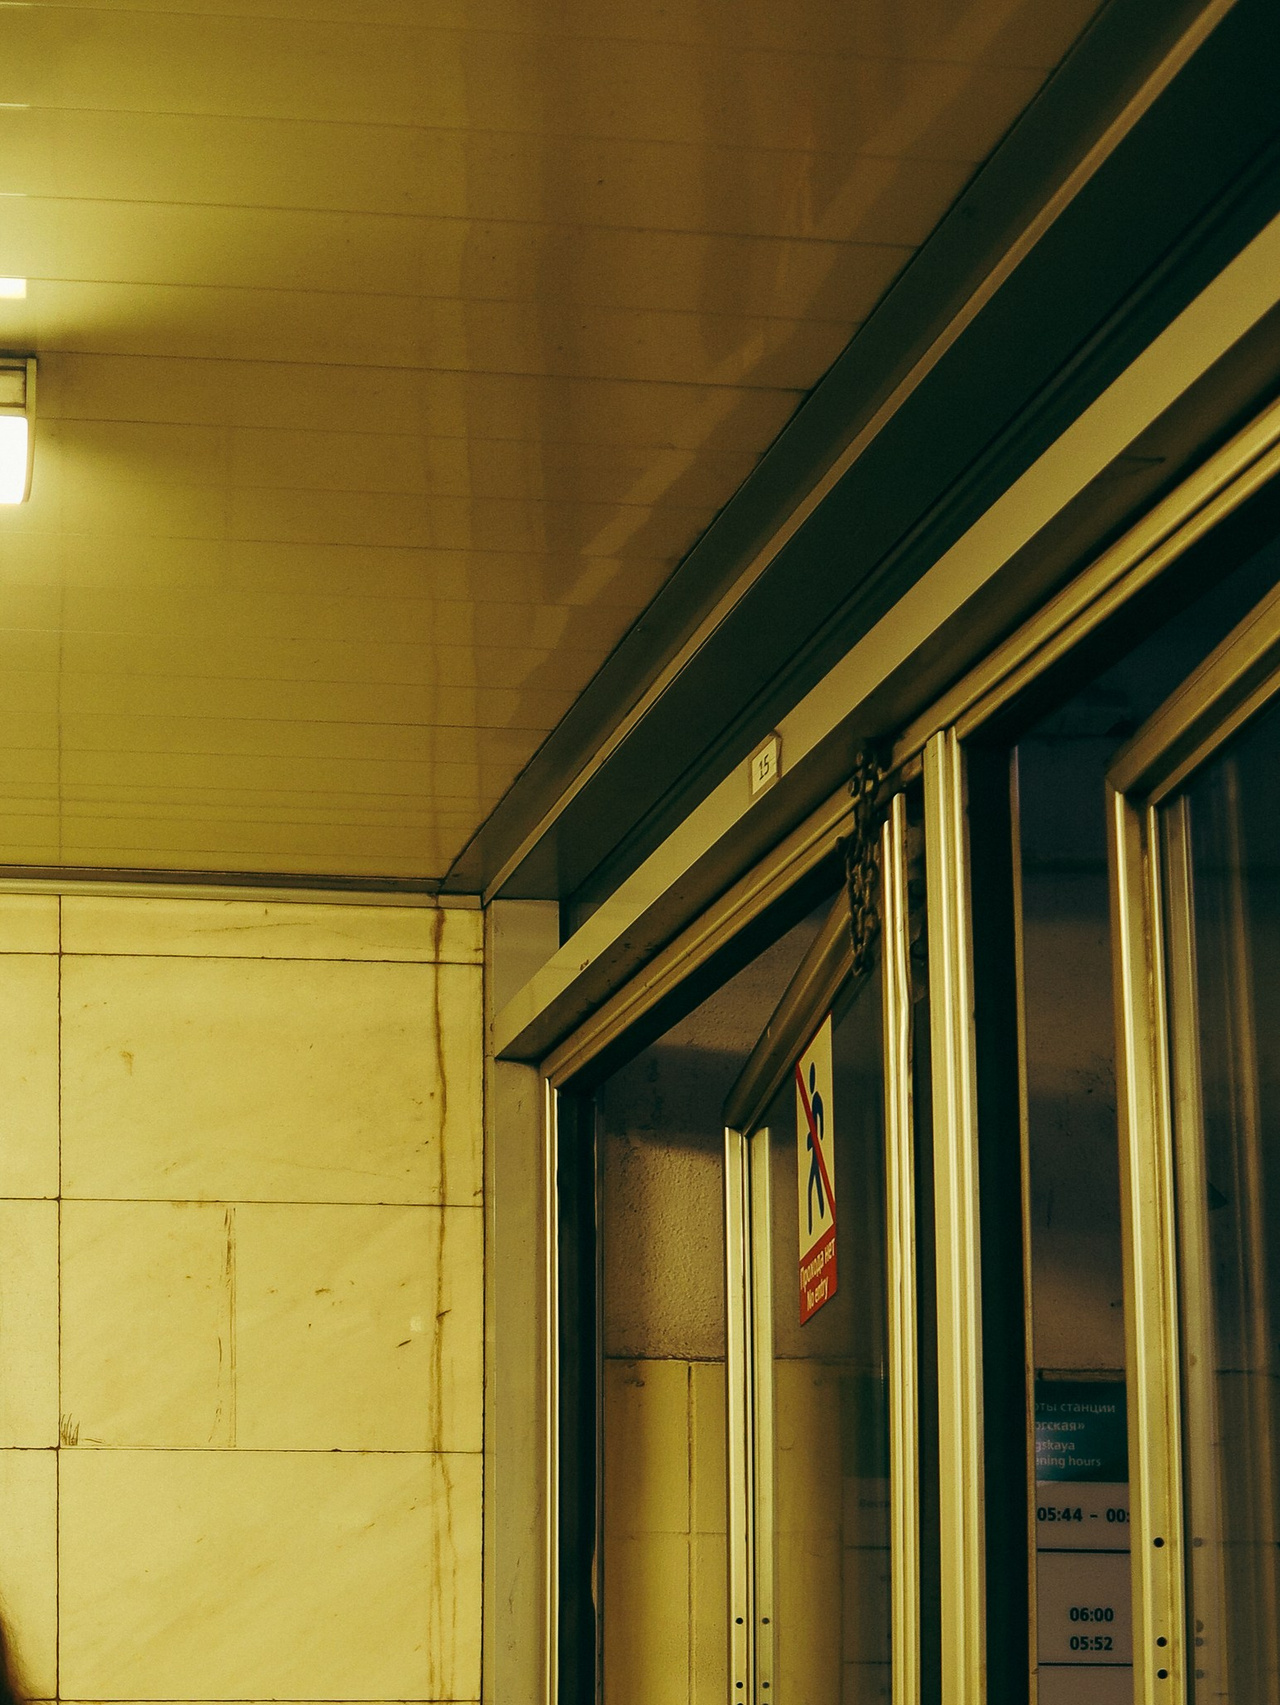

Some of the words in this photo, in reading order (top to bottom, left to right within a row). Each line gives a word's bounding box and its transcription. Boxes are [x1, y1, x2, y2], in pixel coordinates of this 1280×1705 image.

[759, 754, 770, 781] 15
[1060, 1402, 1116, 1414] станции
[1068, 1454, 1102, 1467] hours
[1037, 1507, 1083, 1522] 05:44
[1069, 1607, 1114, 1622] 06:00
[1069, 1636, 1113, 1651] 05:52
